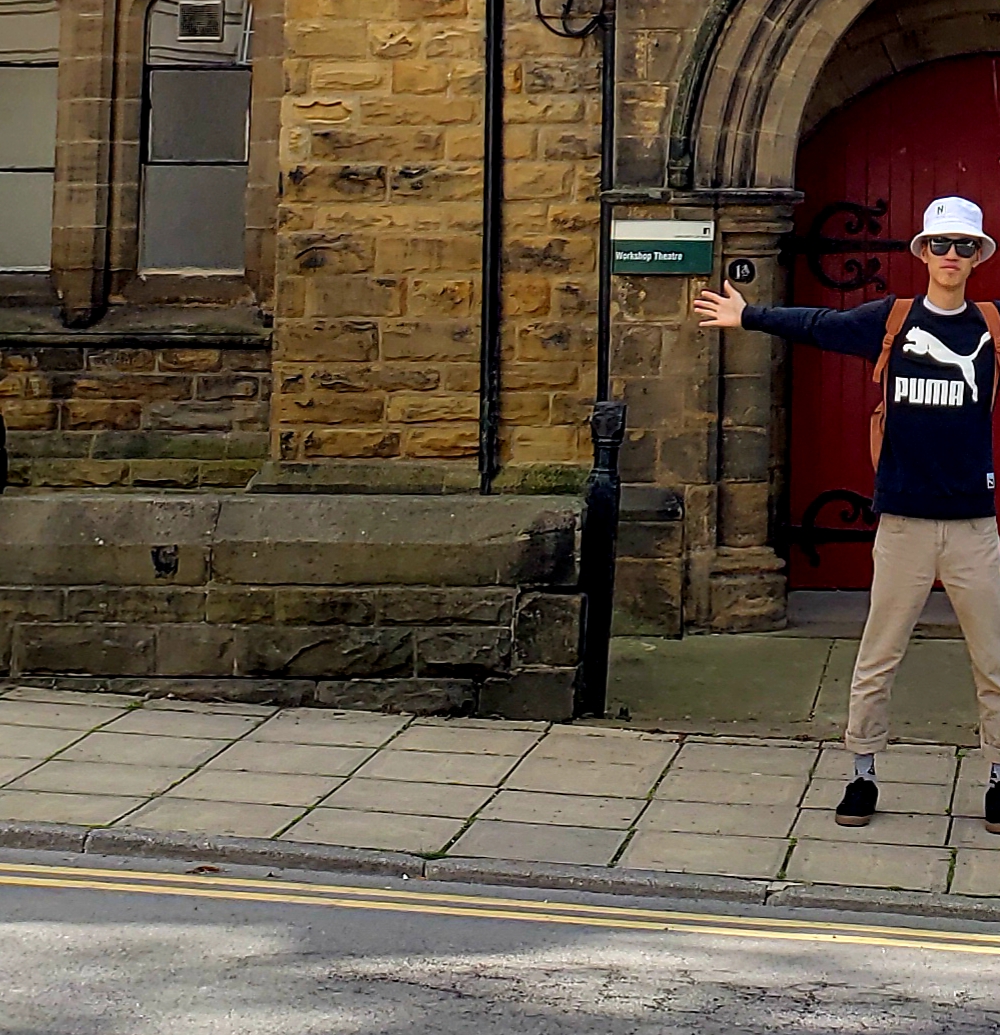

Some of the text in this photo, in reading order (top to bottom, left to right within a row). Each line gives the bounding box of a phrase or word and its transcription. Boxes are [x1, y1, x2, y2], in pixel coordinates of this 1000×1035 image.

[615, 251, 683, 262] Workshop Theatre
[894, 375, 965, 406] PUMA
